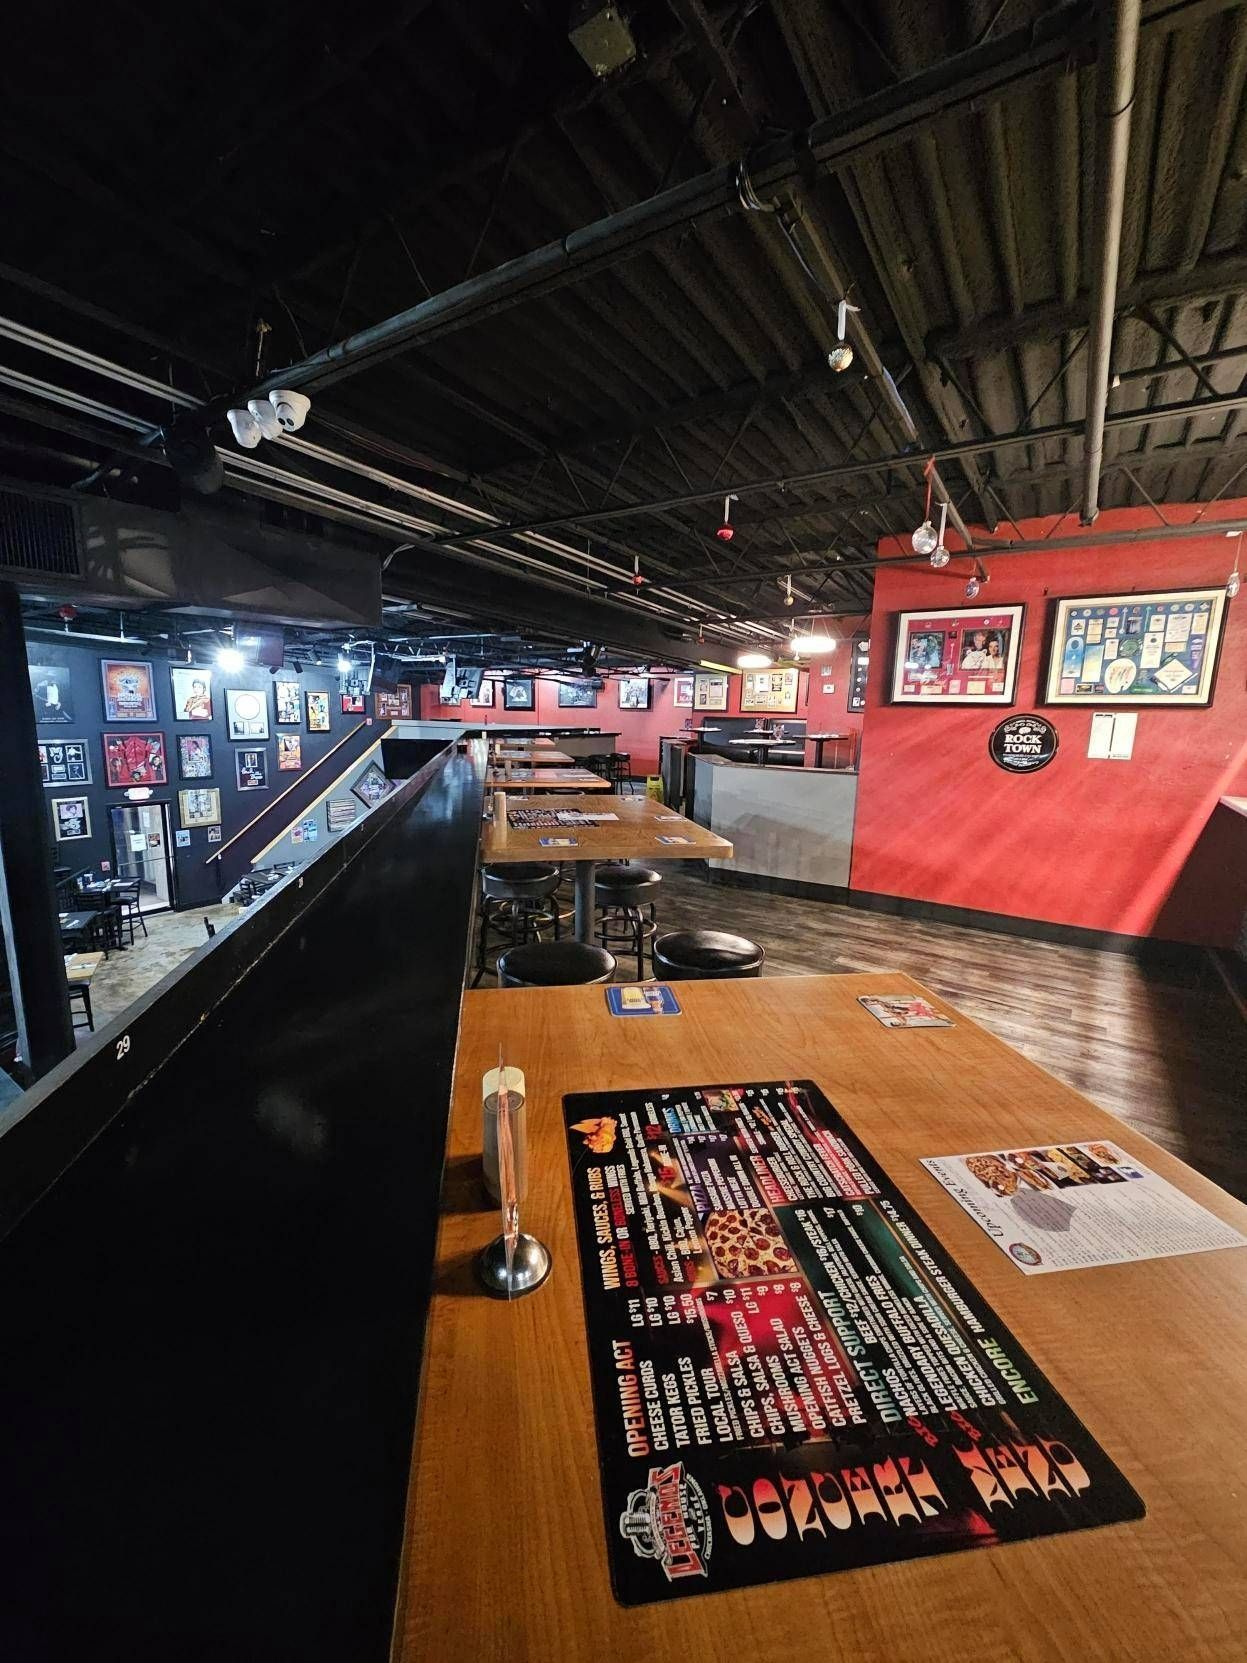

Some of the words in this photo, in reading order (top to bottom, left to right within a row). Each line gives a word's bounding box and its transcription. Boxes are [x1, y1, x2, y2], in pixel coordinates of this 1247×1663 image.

[1003, 743, 1042, 754] TOWN
[1004, 734, 1042, 744] ROCK
[116, 1035, 131, 1060] 29
[662, 1108, 681, 1133] DRINKS
[780, 1119, 797, 1138] SPECIAL
[770, 1131, 788, 1151] BURGER
[792, 1139, 811, 1160] COWBOY
[813, 1143, 830, 1160] FEVER
[822, 1130, 846, 1157] SANDWICH
[732, 1160, 743, 1170] ALL
[783, 1151, 797, 1165] ROLL
[841, 1157, 858, 1172] PORK
[587, 1167, 603, 1191] RUBS
[605, 1165, 618, 1187] WINGS
[616, 1164, 626, 1179] FRIES
[701, 1171, 713, 1186] PIZZA
[727, 1177, 740, 1191] MEAT
[750, 1156, 784, 1203] HEADLINER
[767, 1157, 797, 1201] CHEESEBURGER
[794, 1170, 810, 1186] ROCK
[806, 1161, 828, 1186] COUNTRY
[825, 1160, 855, 1196] CATSCRATCH
[852, 1172, 874, 1194] PULLED
[619, 1179, 630, 1193] WITH
[690, 1185, 706, 1211] PIZZA
[707, 1186, 723, 1211] SAUSAGE
[719, 1186, 735, 1210] MASSIVE
[744, 1186, 761, 1208] DOUBLE
[803, 1186, 817, 1199] THE
[822, 1186, 836, 1197] BIG
[622, 1193, 635, 1215] SERVED
[734, 1191, 748, 1209] LOTTA
[880, 1200, 899, 1221] $14.75
[953, 1187, 1004, 1237] Upcoming
[593, 1201, 612, 1244] SAUCES,
[616, 1227, 629, 1239] OR
[896, 1222, 922, 1249] DINNER
[599, 1246, 620, 1289] WINGS,
[671, 1261, 684, 1282] Asian
[916, 1250, 942, 1275] STEAK
[705, 1291, 718, 1301] $7
[723, 1289, 736, 1304] $10
[740, 1287, 753, 1300] $11
[756, 1286, 768, 1296] $9
[866, 1275, 888, 1300] FRIES
[628, 1299, 640, 1313] $11
[645, 1297, 658, 1313] $10
[663, 1295, 676, 1311] $10
[680, 1294, 697, 1323] $15.50
[745, 1302, 760, 1314] LG
[795, 1295, 821, 1331] CHEESE
[936, 1276, 984, 1332] HAMBURGER
[631, 1314, 644, 1327] LG
[649, 1313, 663, 1326] LG
[667, 1311, 681, 1324] LG
[731, 1311, 752, 1343] QUESO
[818, 1291, 865, 1356] SUPPORT
[882, 1301, 915, 1343] BUFFALO
[914, 1296, 960, 1355] QUESADILLA
[770, 1318, 793, 1351] SALAD
[854, 1319, 877, 1344] BEEF
[612, 1340, 634, 1369] ACT
[743, 1345, 756, 1353] &
[792, 1327, 823, 1374] NUGGETS
[818, 1342, 840, 1369] LOGS
[922, 1344, 940, 1366] TOPPED
[725, 1350, 747, 1386] SALSA
[747, 1355, 769, 1391] SALSA
[784, 1353, 803, 1373] ACT
[889, 1353, 908, 1381] TORTILLA
[936, 1367, 951, 1384] FRIES
[978, 1339, 1038, 1403] ENCORE
[640, 1360, 658, 1398] CURDS
[662, 1373, 680, 1404] KEGS
[678, 1357, 701, 1404] PICKLES
[701, 1368, 720, 1399] TOUR
[904, 1382, 914, 1390] OF
[908, 1346, 957, 1411] LEGENDARY
[954, 1357, 995, 1406] CHICKEN
[738, 1388, 751, 1397] &
[766, 1356, 806, 1431] MUSHROOMS
[794, 1376, 826, 1429] OPENING
[814, 1377, 846, 1426] CATFISH
[833, 1371, 866, 1424] PRETZEL
[854, 1361, 901, 1422] DIRECT
[882, 1368, 918, 1416] NACHOS
[910, 1390, 929, 1415] LAYERS
[921, 1392, 939, 1413] BLACK
[947, 1385, 967, 1410] WAFFLE
[984, 1379, 1006, 1404] GRILLED
[618, 1375, 648, 1456] OPENING
[647, 1401, 669, 1450] CHEESE
[691, 1407, 712, 1444] FRIED
[711, 1401, 733, 1442] LOCAL
[741, 1400, 764, 1437] CHIPS
[761, 1393, 785, 1434] CHIPS,
[950, 1411, 983, 1441] BIG
[669, 1407, 690, 1448] TATOR
[732, 1420, 744, 1440] FRIED
[908, 1416, 940, 1449] BIG
[951, 1433, 1092, 1513] MENU
[717, 1454, 948, 1546] CONCERT
[649, 1461, 705, 1580] LEGENDS
